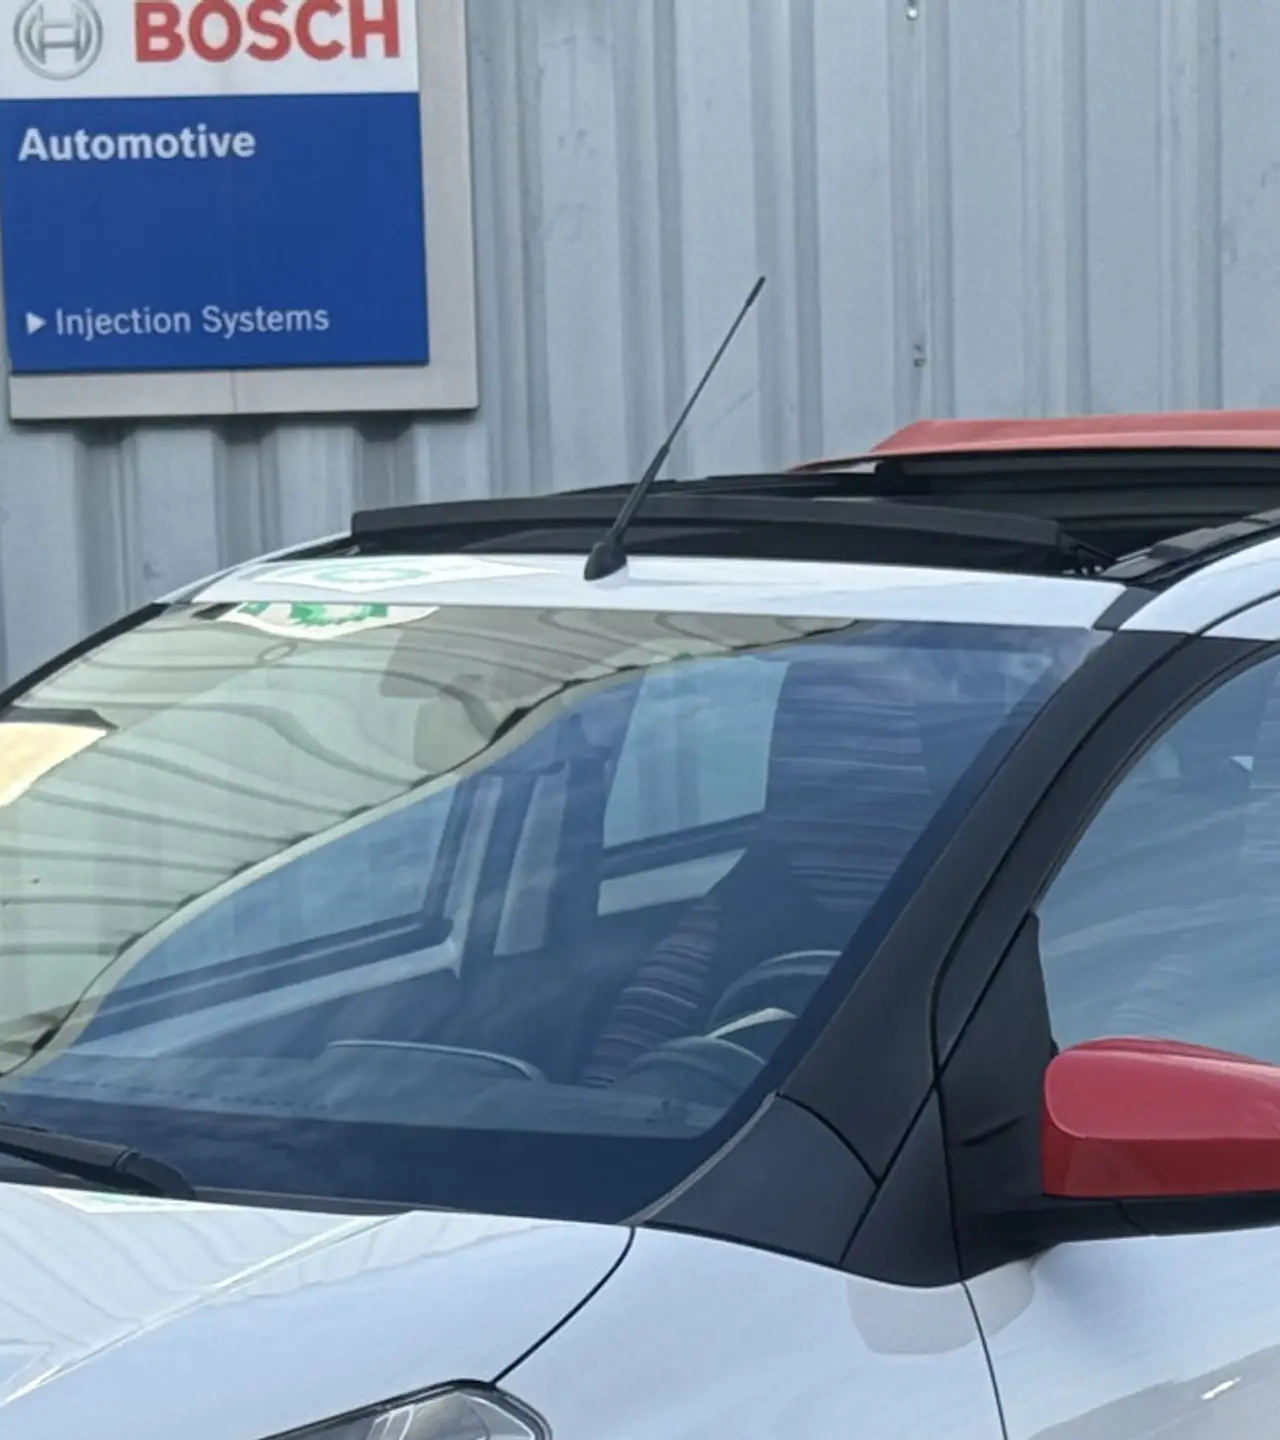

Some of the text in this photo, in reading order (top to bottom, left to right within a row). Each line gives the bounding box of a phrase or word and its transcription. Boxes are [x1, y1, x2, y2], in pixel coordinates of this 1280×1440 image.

[133, 0, 401, 62] BOSCH
[17, 123, 257, 161] Automotive
[54, 304, 330, 341] Injection Systems
